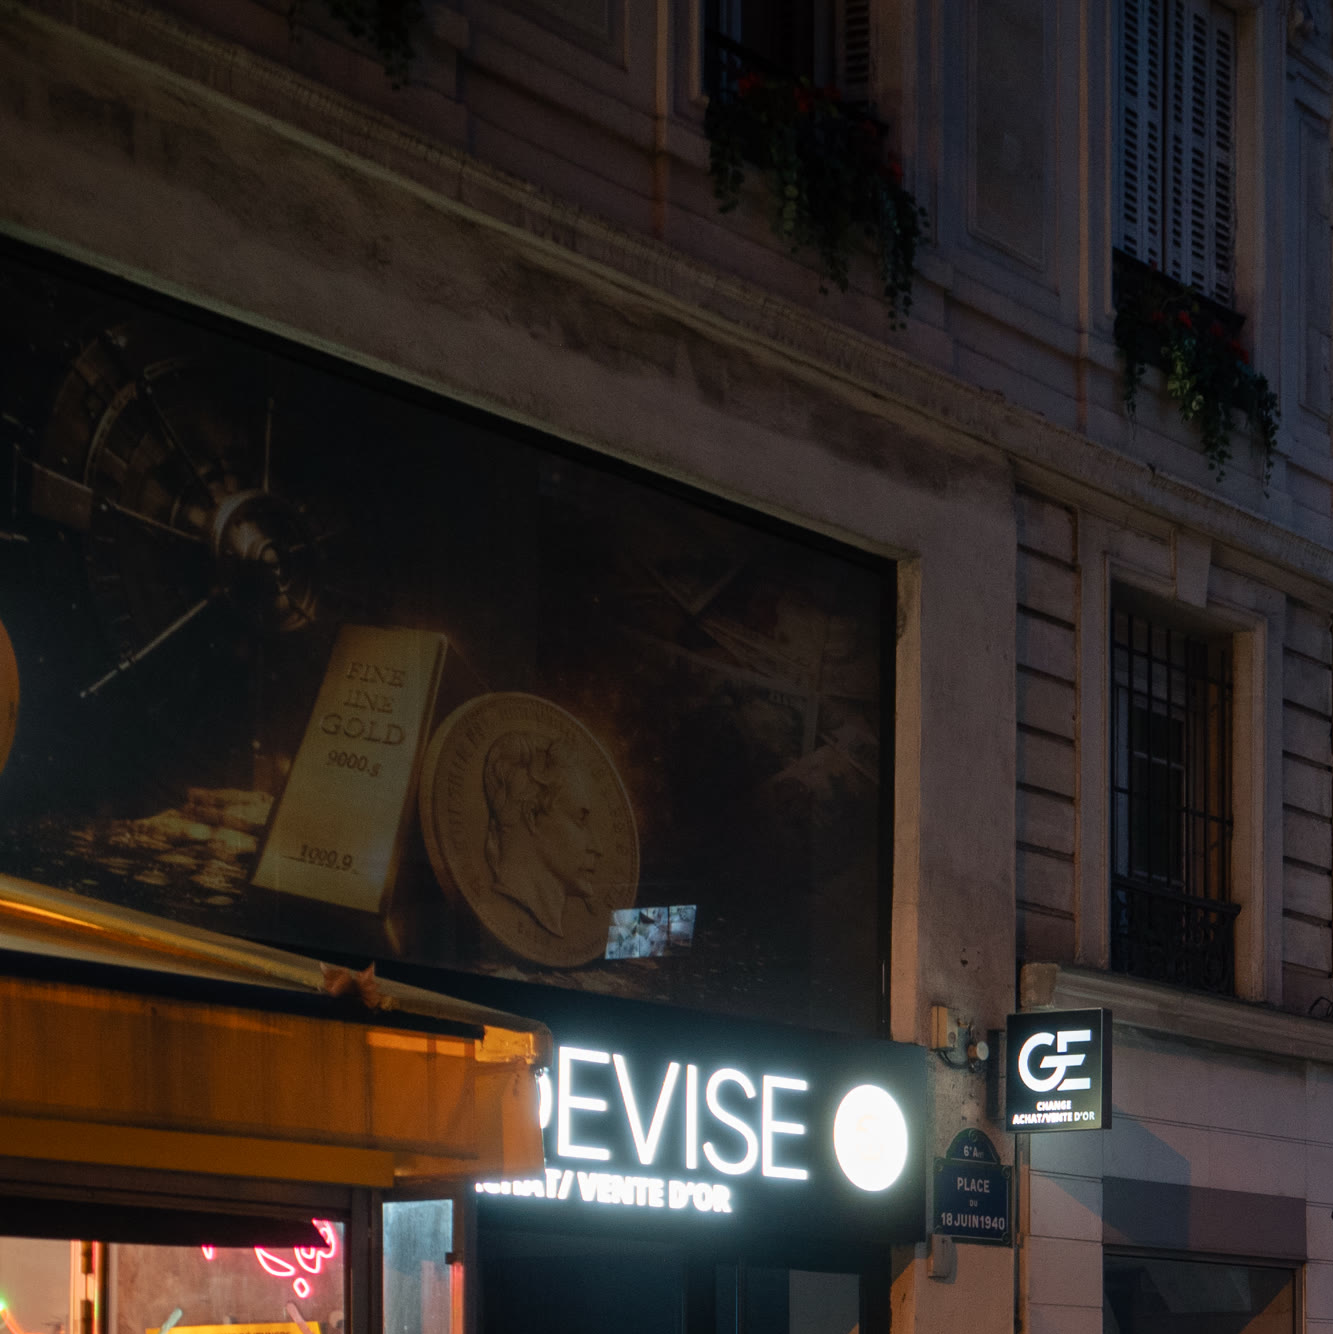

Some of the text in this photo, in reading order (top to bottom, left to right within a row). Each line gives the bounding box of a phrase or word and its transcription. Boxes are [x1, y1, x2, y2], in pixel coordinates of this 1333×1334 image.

[345, 661, 405, 688] FINE
[320, 713, 406, 746] GOLD
[1017, 1029, 1093, 1093] GE
[538, 1045, 808, 1181] EVISE
[1036, 1099, 1073, 1112] CHANGE
[576, 1171, 663, 1208] VENTE
[668, 1180, 732, 1213] D'OR
[957, 1177, 991, 1194] PLACE
[969, 1199, 979, 1207] DU
[941, 1212, 1006, 1231] 18 JUIN 1940
